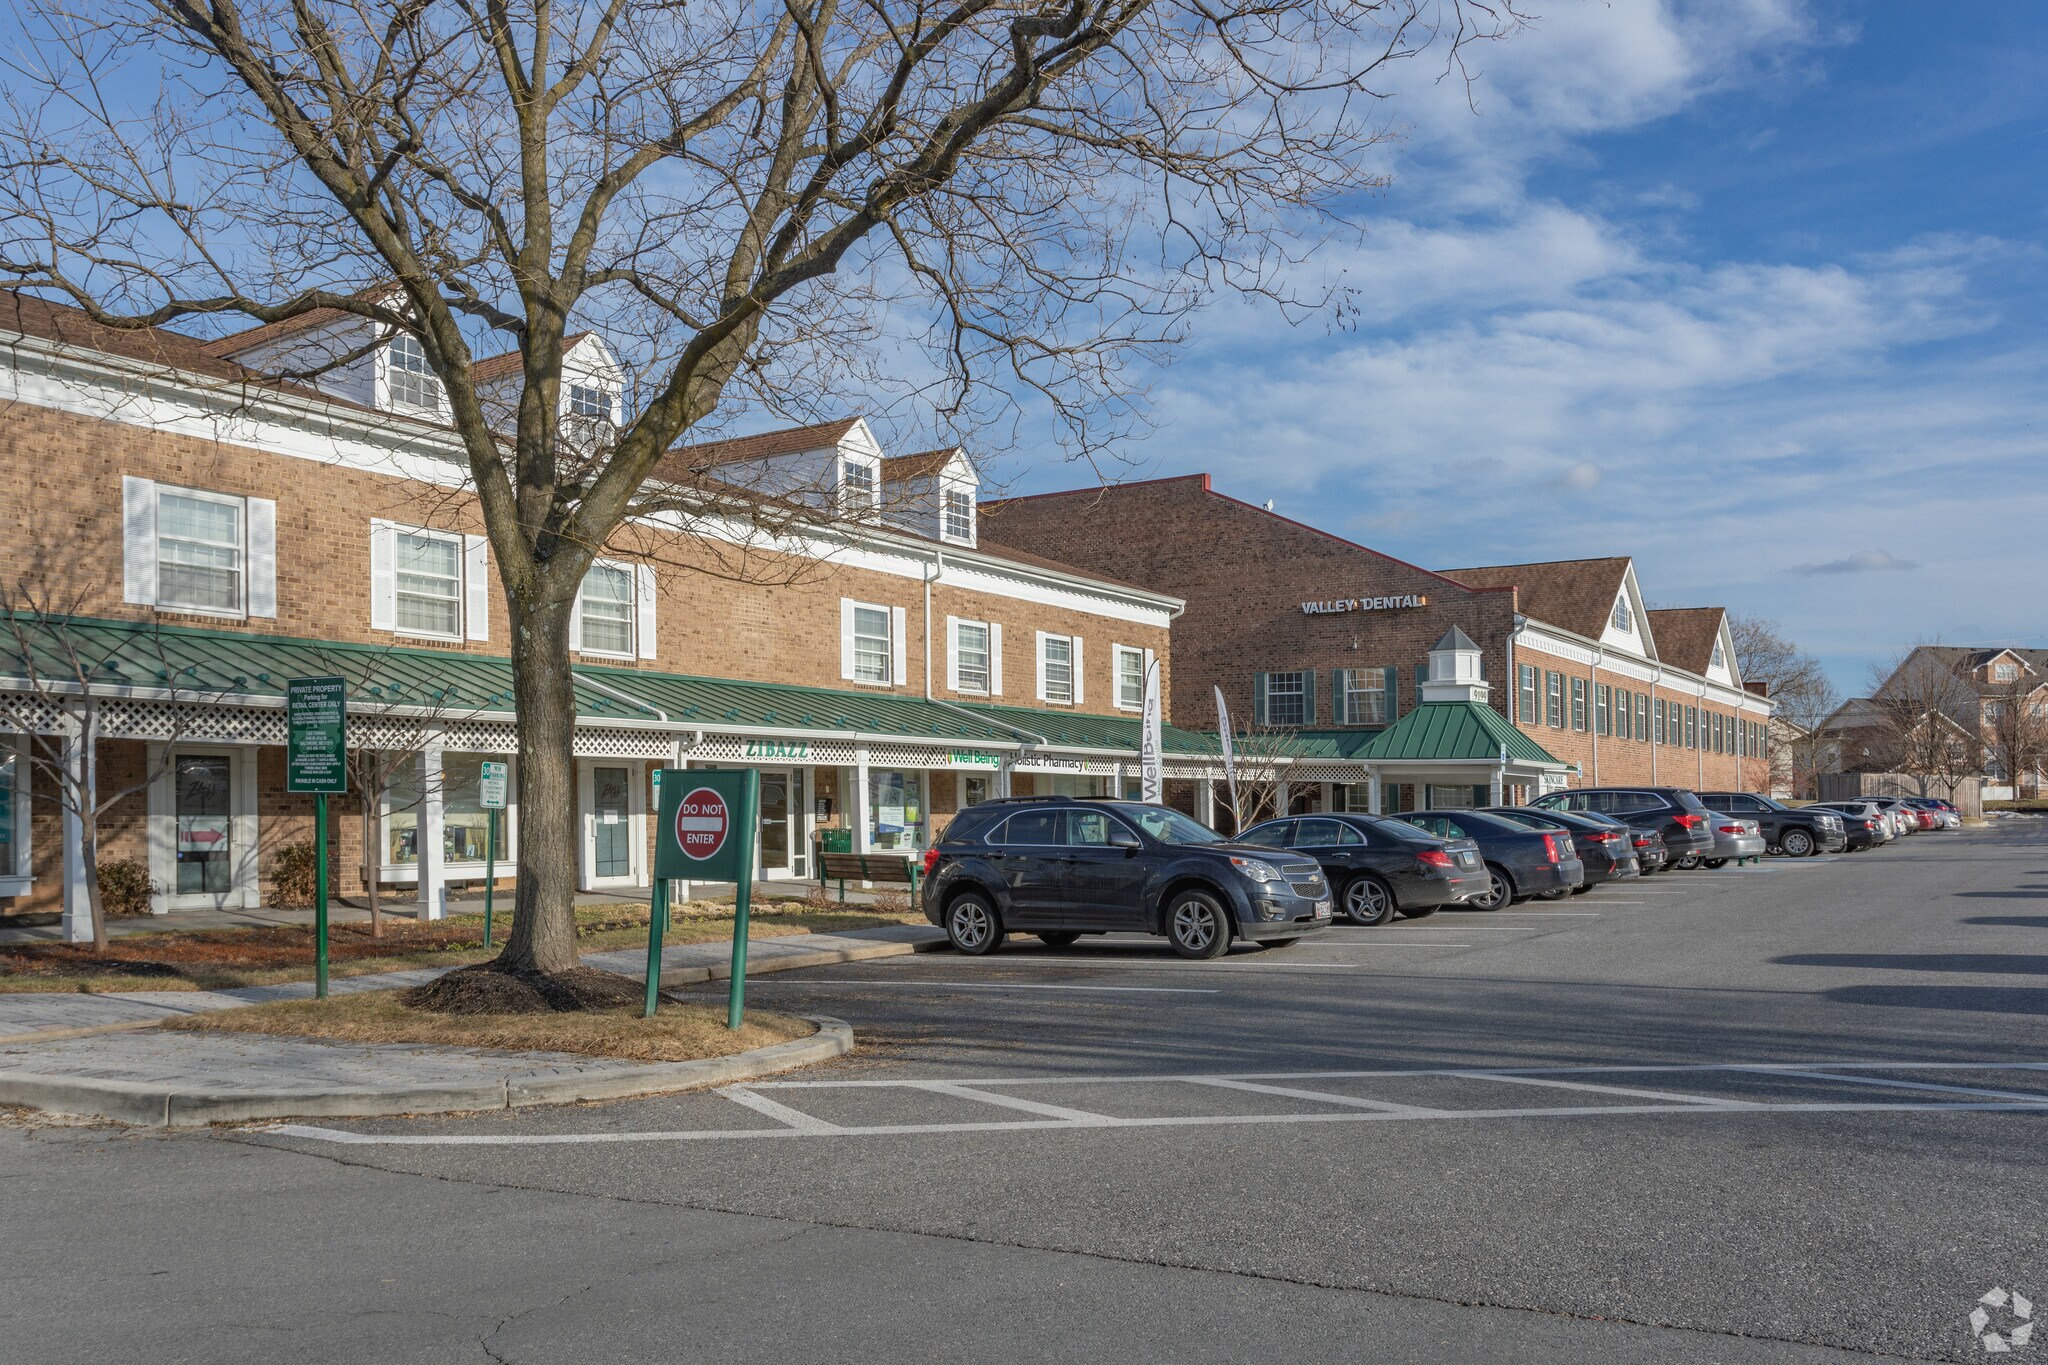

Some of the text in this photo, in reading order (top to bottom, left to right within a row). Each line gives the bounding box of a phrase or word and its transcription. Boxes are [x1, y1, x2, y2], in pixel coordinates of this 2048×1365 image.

[1301, 595, 1422, 614] VALLEY DENTAL
[290, 684, 342, 694] PRIVATE PROPERTY
[745, 739, 808, 758] ZIBAZZ
[952, 749, 1000, 767] Well Being
[1043, 754, 1083, 772] Pharmacy
[683, 804, 723, 815] DO NOT
[686, 833, 715, 844] ENTER
